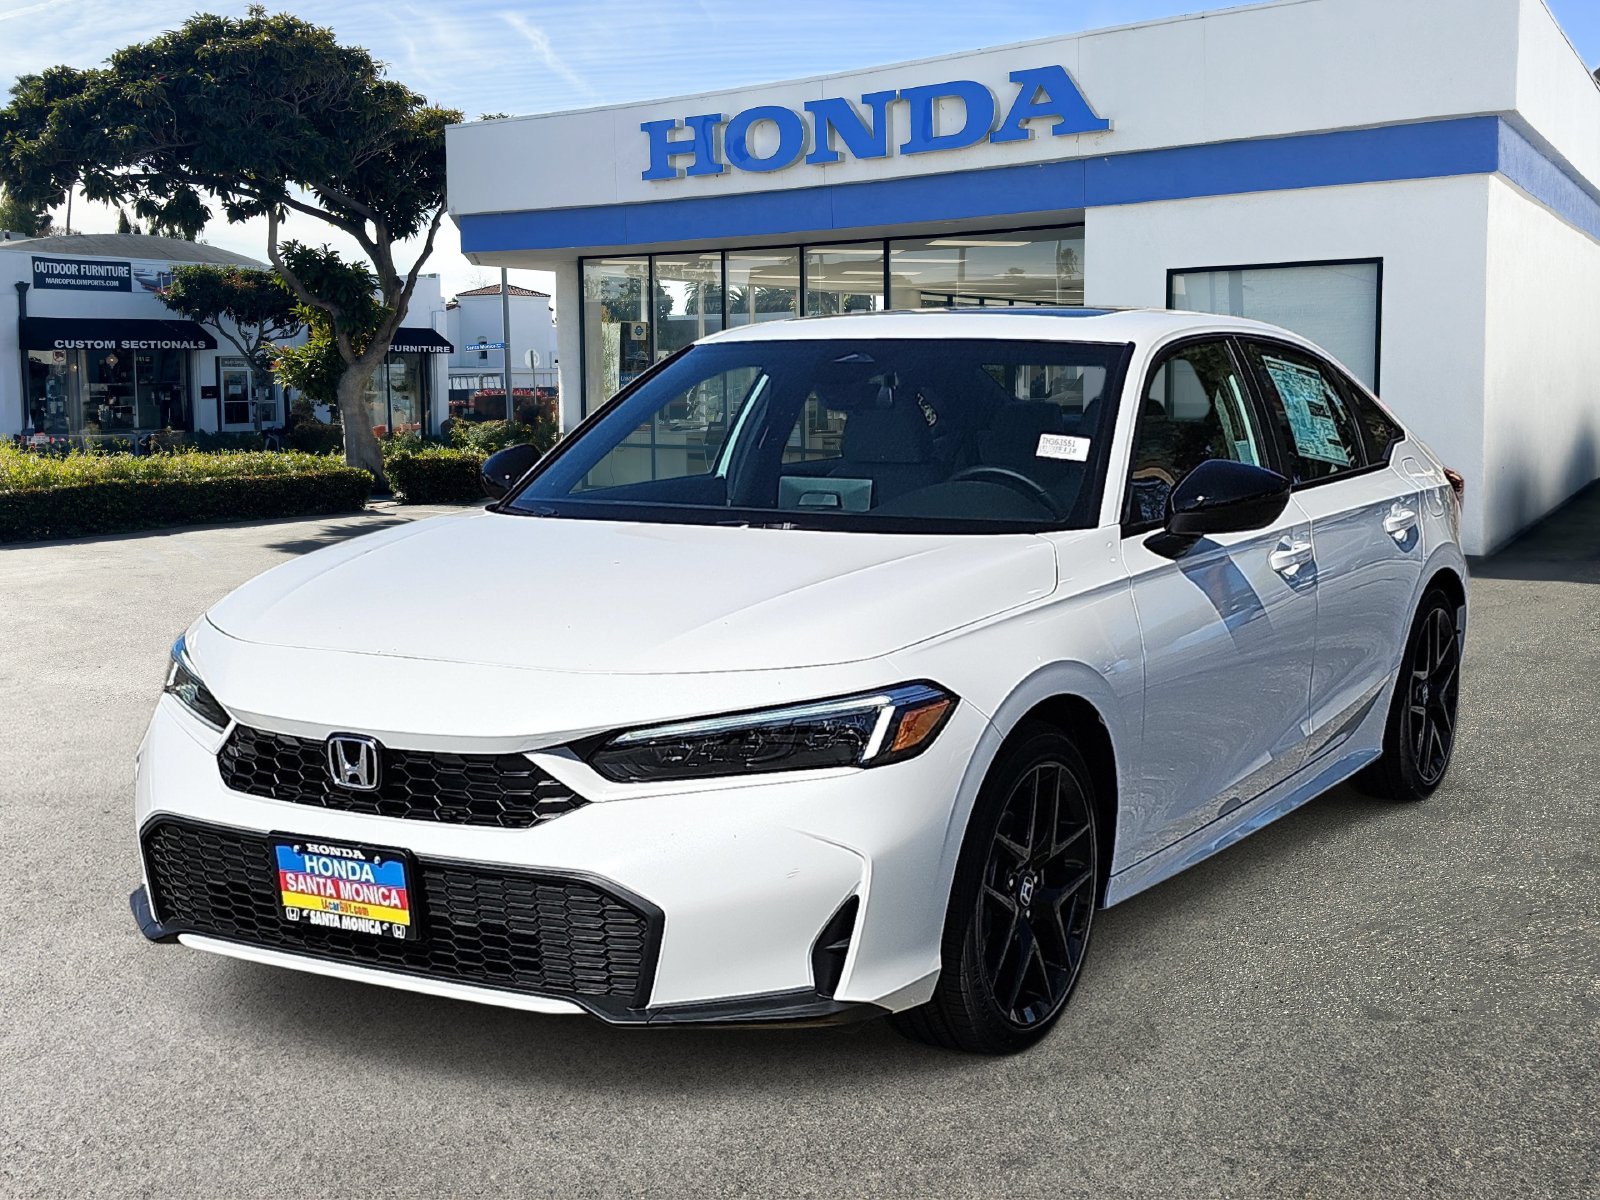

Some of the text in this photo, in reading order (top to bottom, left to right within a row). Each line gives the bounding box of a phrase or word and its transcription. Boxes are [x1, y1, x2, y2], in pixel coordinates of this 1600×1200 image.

[640, 65, 1112, 181] HONDA
[34, 261, 130, 278] OUTDOOR FURNITURE
[45, 277, 120, 287] MARCOPOLOIMPORTS.COM
[54, 340, 206, 350] CUSTOM SECTIONALS
[388, 344, 451, 353] FURNITURE
[305, 843, 366, 860] HONDA
[303, 855, 375, 883] HONDA
[286, 873, 402, 908] SANTA MONICA
[309, 910, 383, 936] SANTA MONICA
